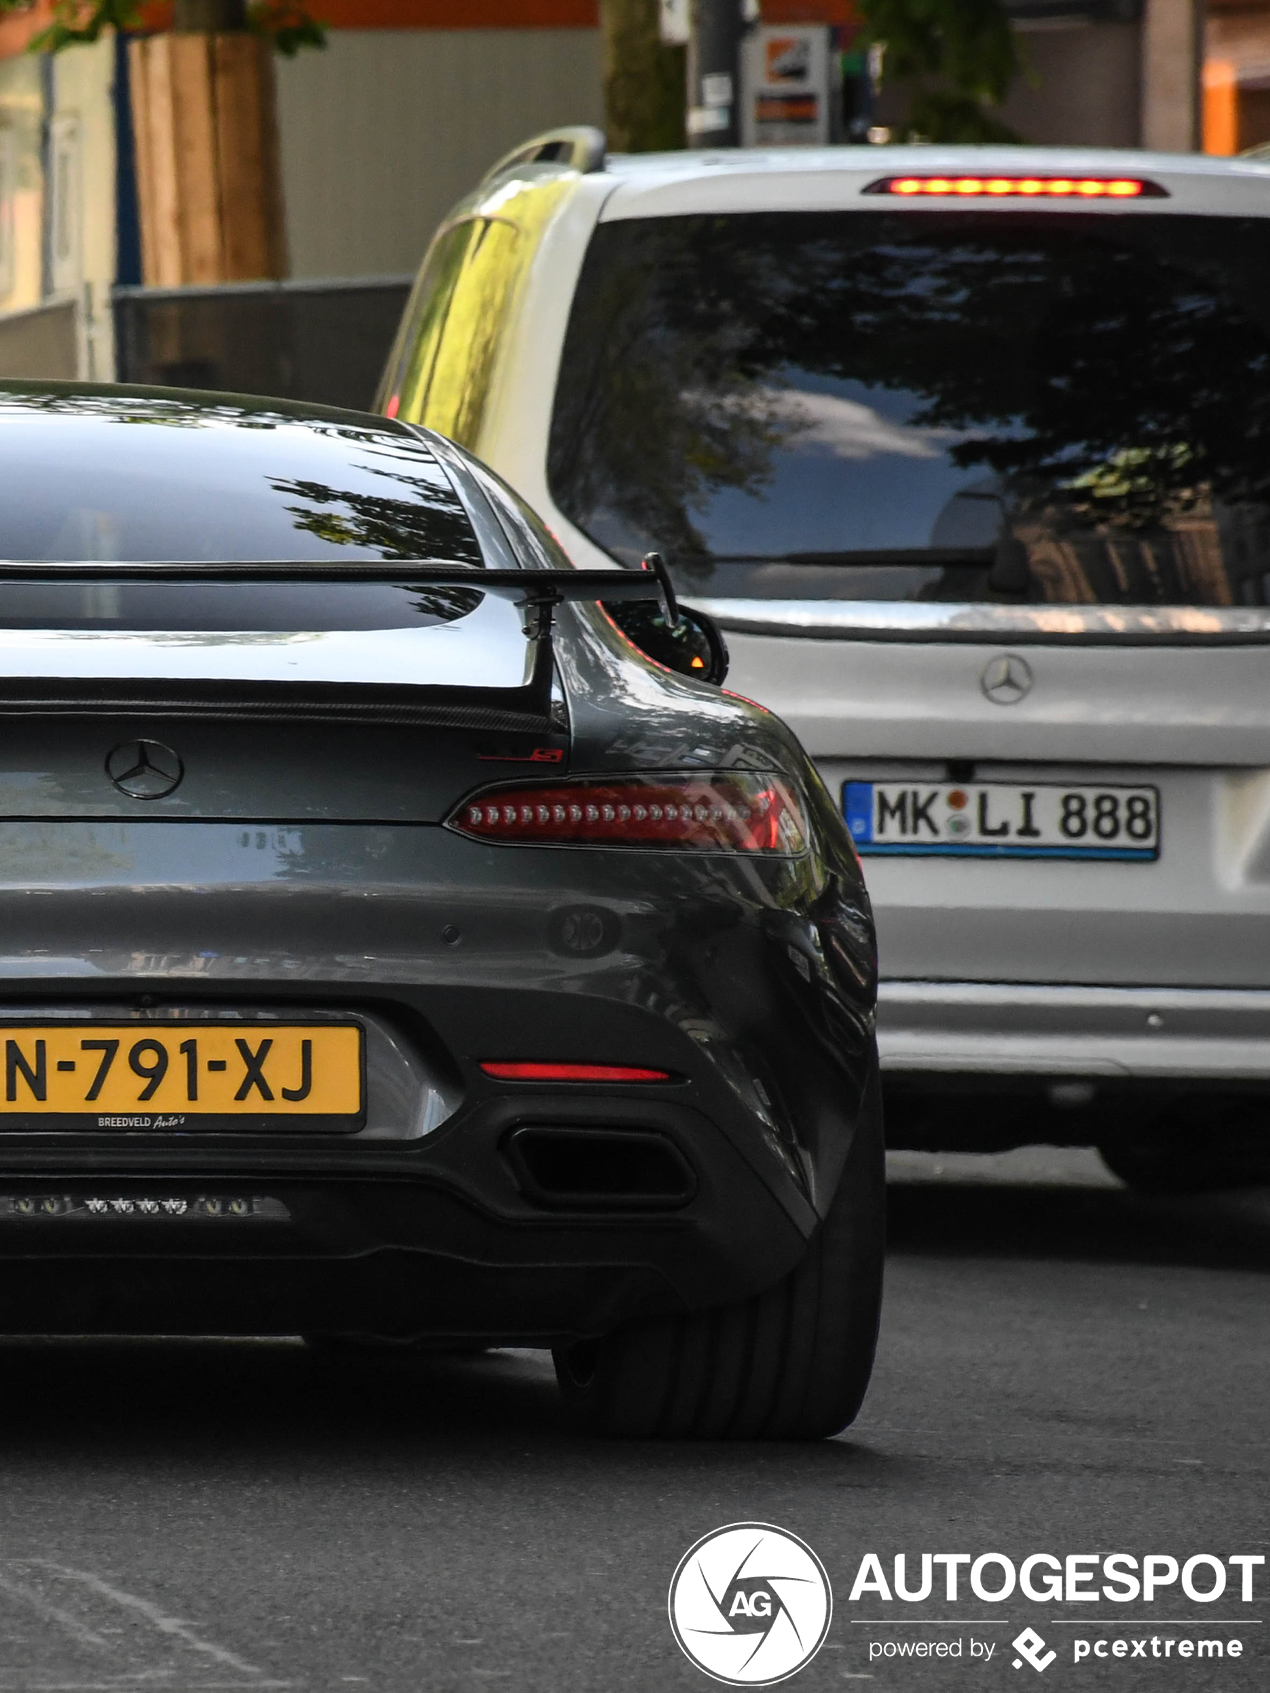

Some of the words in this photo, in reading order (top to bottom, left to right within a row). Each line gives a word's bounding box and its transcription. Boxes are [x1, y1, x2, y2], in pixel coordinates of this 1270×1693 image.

[877, 790, 939, 835] MK
[979, 791, 1041, 837] LI
[1060, 794, 1153, 839] 888
[5, 1038, 313, 1101] N-791-XJ
[98, 1117, 151, 1128] BREEDVELD
[152, 1115, 186, 1129] Auto's
